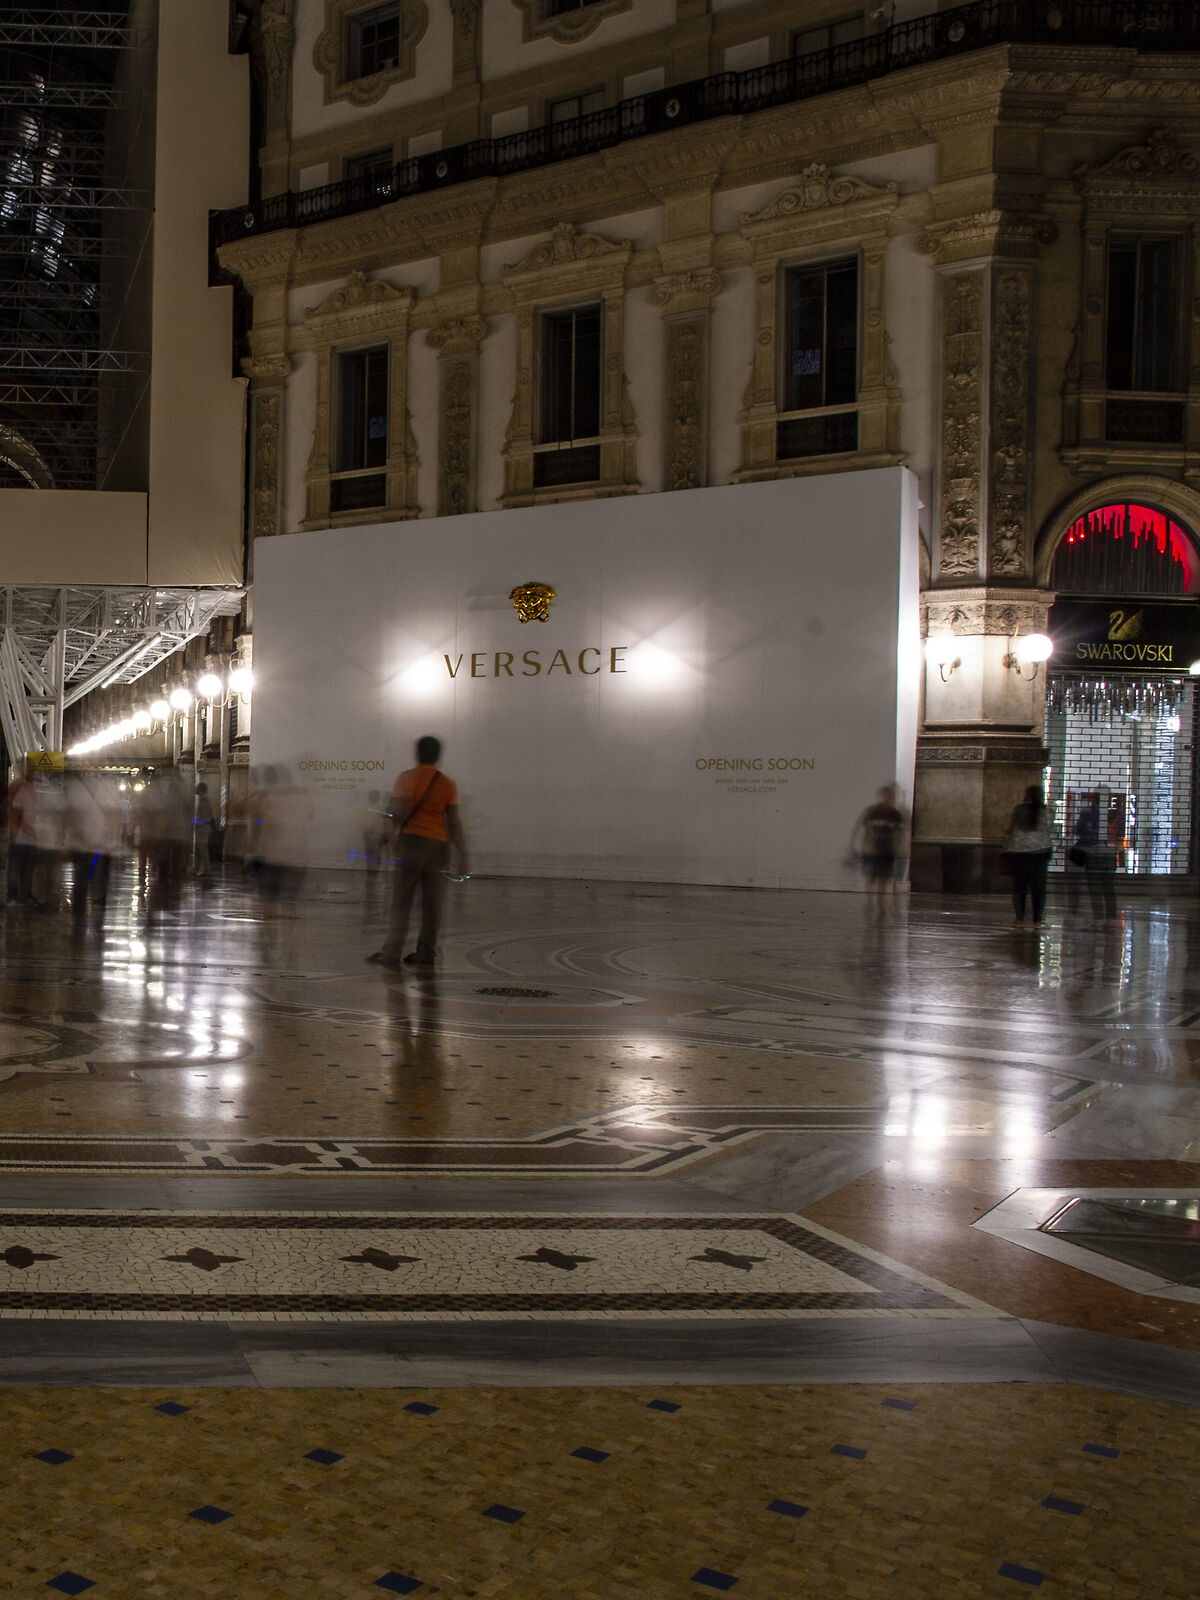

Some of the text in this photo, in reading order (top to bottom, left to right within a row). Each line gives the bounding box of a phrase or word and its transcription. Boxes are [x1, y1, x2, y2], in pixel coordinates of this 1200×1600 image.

[1076, 642, 1174, 662] SWAROVSKI
[443, 646, 628, 679] VERSACE
[298, 760, 385, 771] OPENING SOON
[695, 758, 815, 770] OPENING SOON
